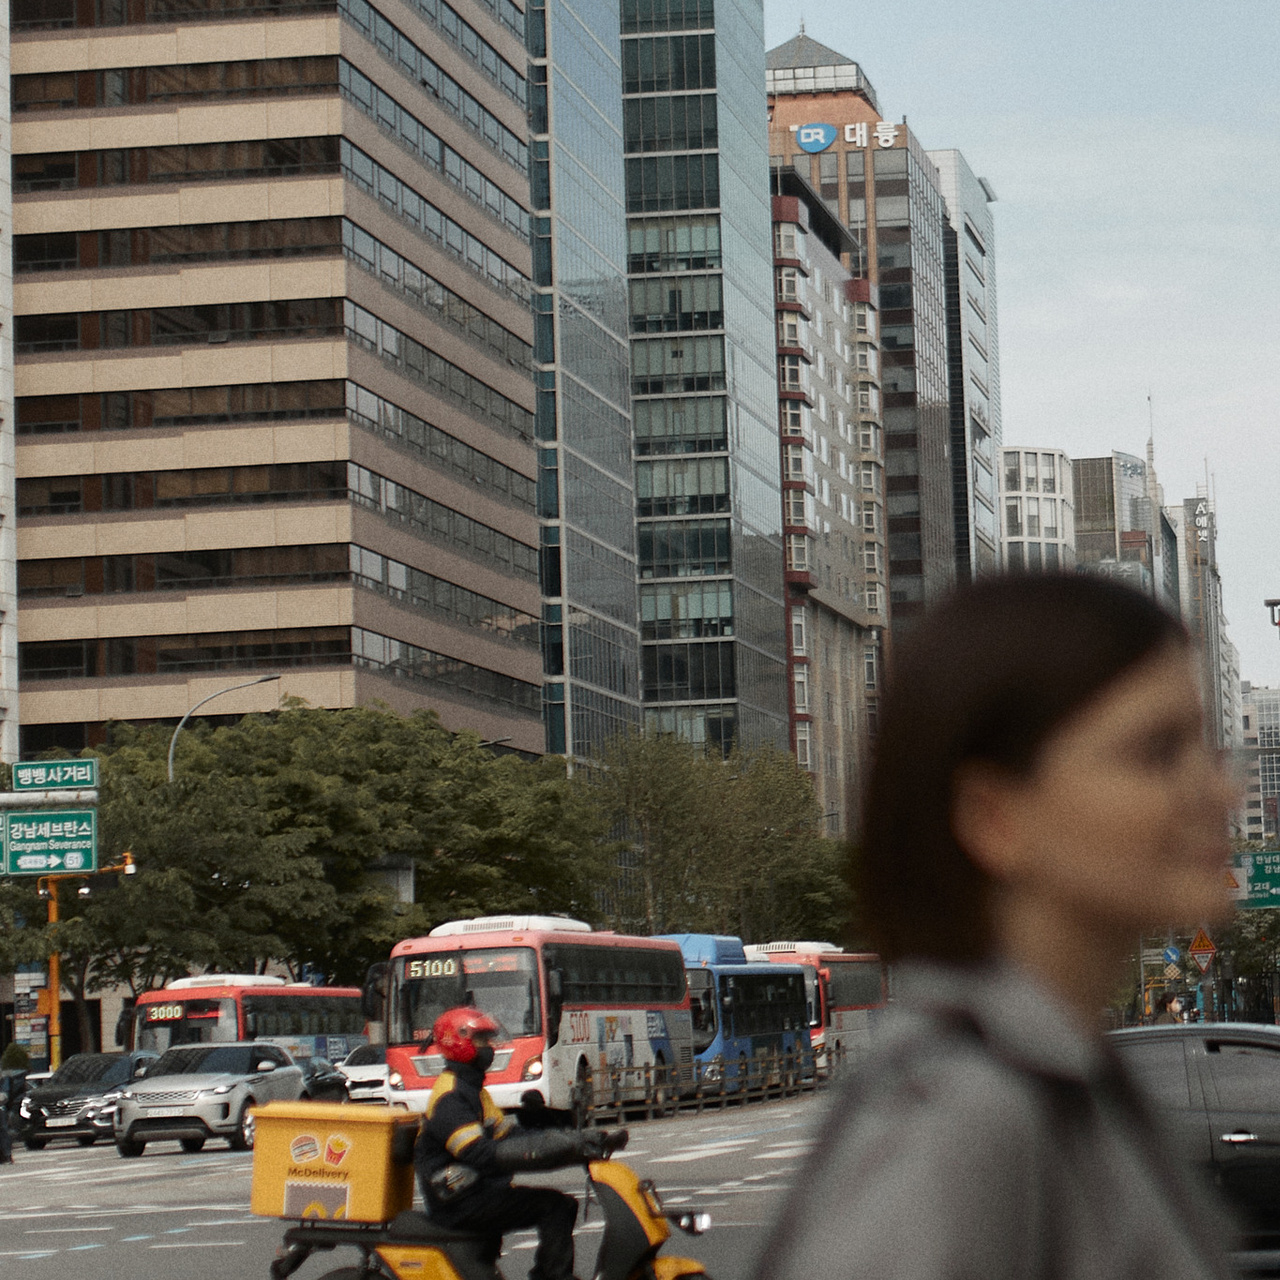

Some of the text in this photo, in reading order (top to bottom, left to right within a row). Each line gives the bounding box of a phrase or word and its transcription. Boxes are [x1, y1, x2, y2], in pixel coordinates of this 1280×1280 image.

[17, 765, 91, 785] 뱅뱅사거리
[10, 821, 92, 840] 강남세브란스
[10, 839, 92, 853] Gangnam Severance
[410, 959, 457, 978] 5100
[149, 1005, 183, 1020] 3000
[287, 1167, 349, 1181] McDelivery
